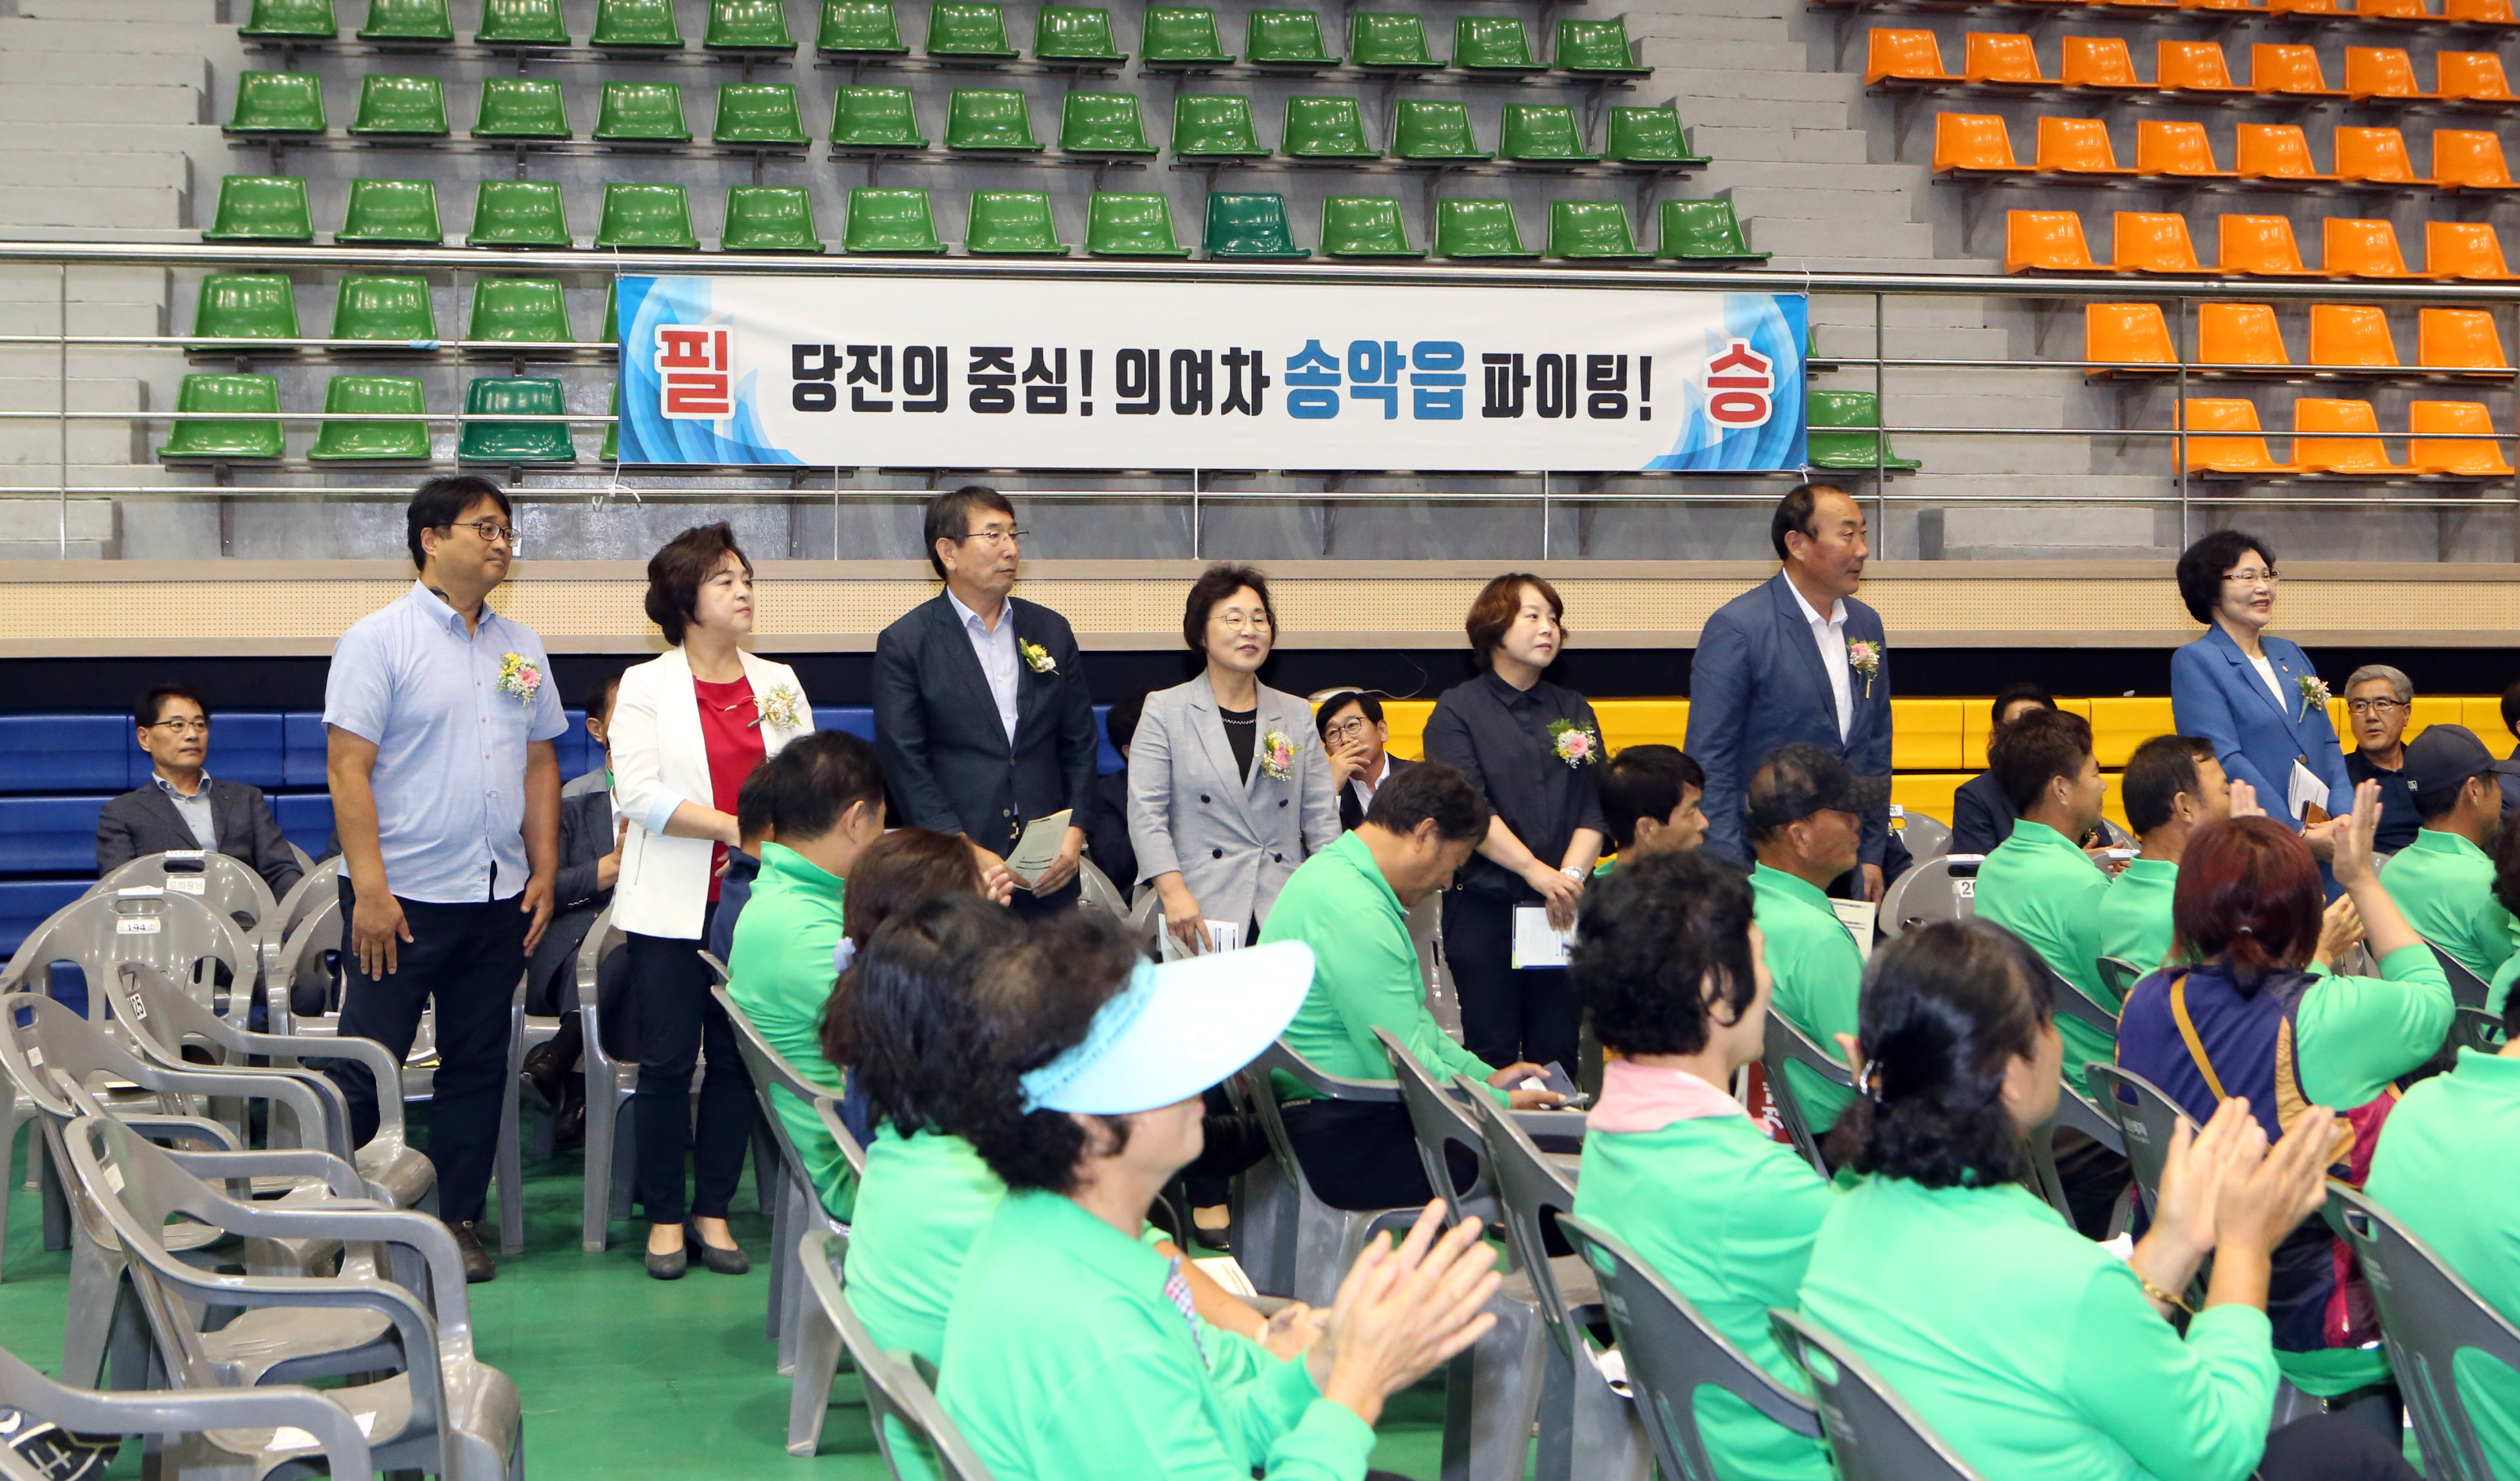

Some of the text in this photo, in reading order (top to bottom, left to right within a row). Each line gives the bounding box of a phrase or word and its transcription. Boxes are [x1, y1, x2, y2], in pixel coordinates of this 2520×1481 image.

[660, 330, 729, 413] 필
[791, 339, 1653, 421] 당진의 중심! 의여차 송악읍 파이팅!
[1707, 343, 1769, 423] 승
[127, 923, 146, 932] 194
[132, 996, 144, 1016] 25
